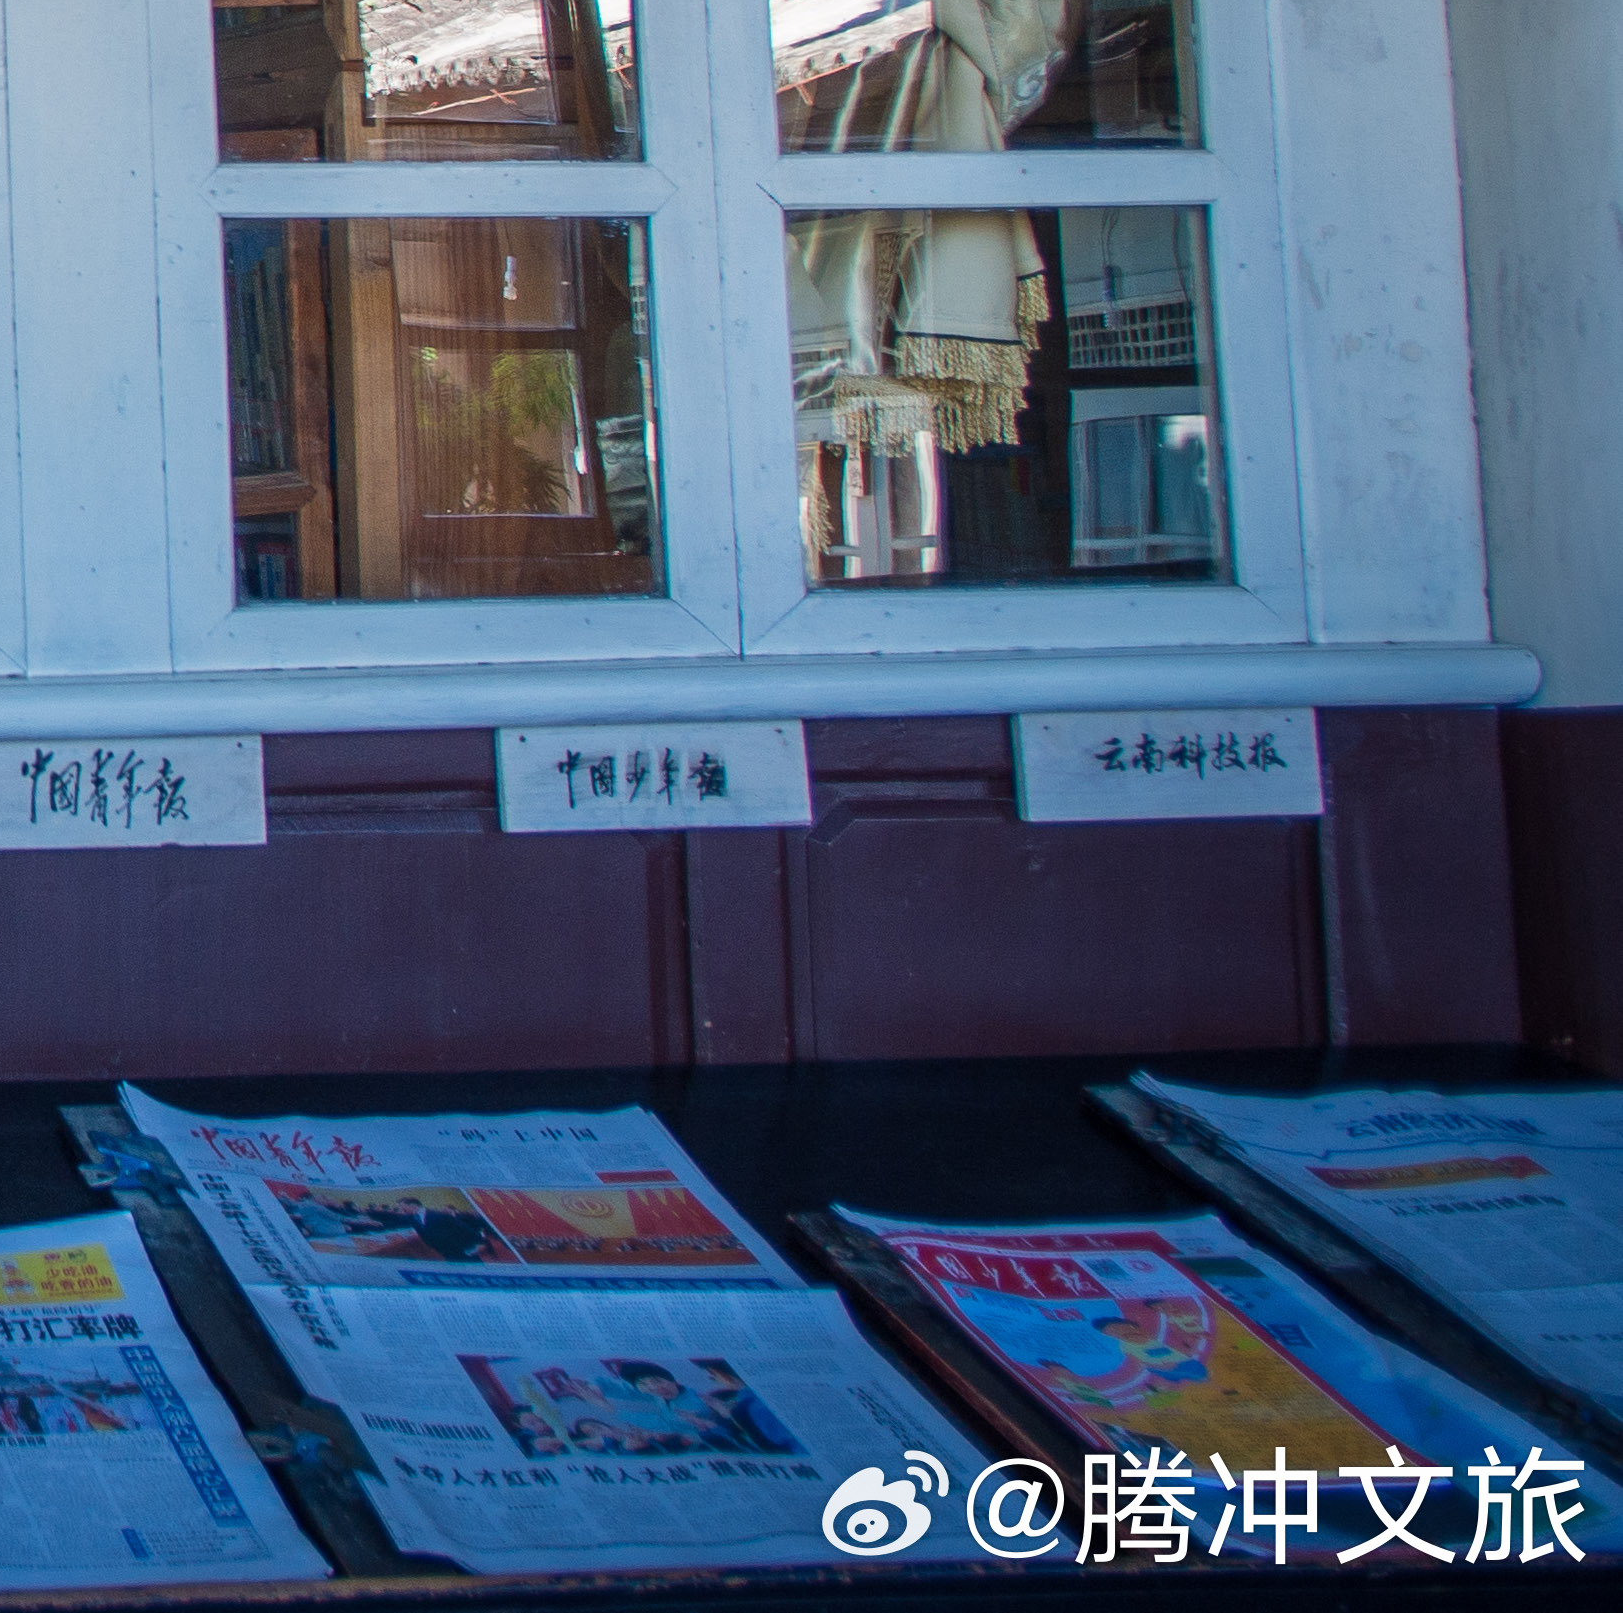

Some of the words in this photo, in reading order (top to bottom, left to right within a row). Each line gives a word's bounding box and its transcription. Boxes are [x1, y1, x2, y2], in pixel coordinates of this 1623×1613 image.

[1095, 732, 1287, 779] 云南科技报
[393, 1456, 555, 1488] 争夺人才红利
